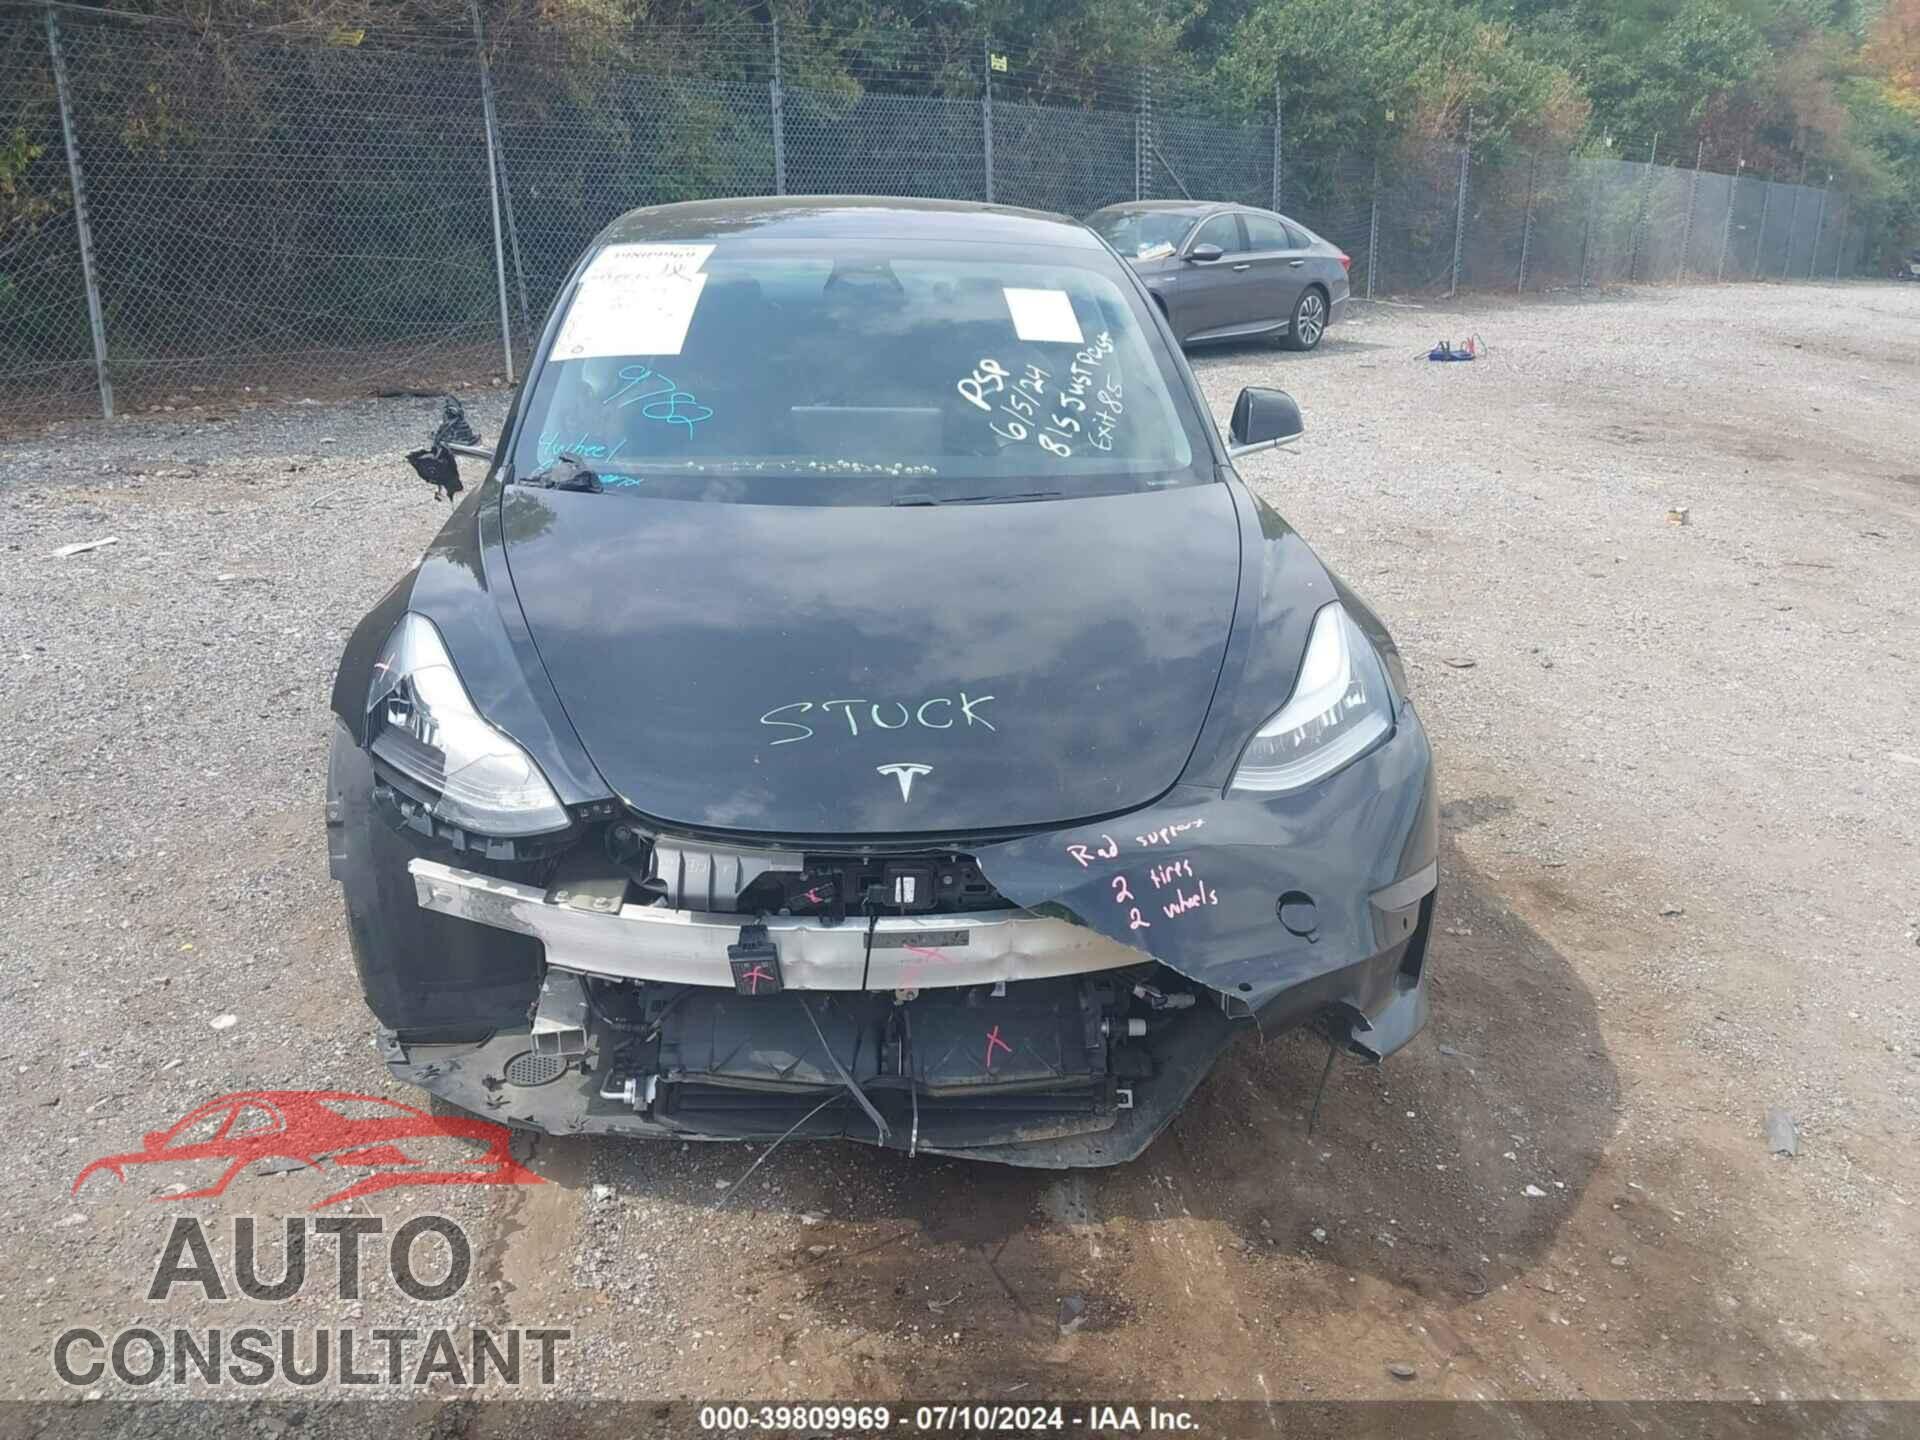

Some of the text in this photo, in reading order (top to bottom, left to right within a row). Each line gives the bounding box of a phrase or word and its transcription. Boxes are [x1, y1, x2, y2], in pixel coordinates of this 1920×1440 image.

[760, 692, 996, 745] STUCK
[1112, 876, 1134, 903] 2
[1130, 908, 1150, 930] 2
